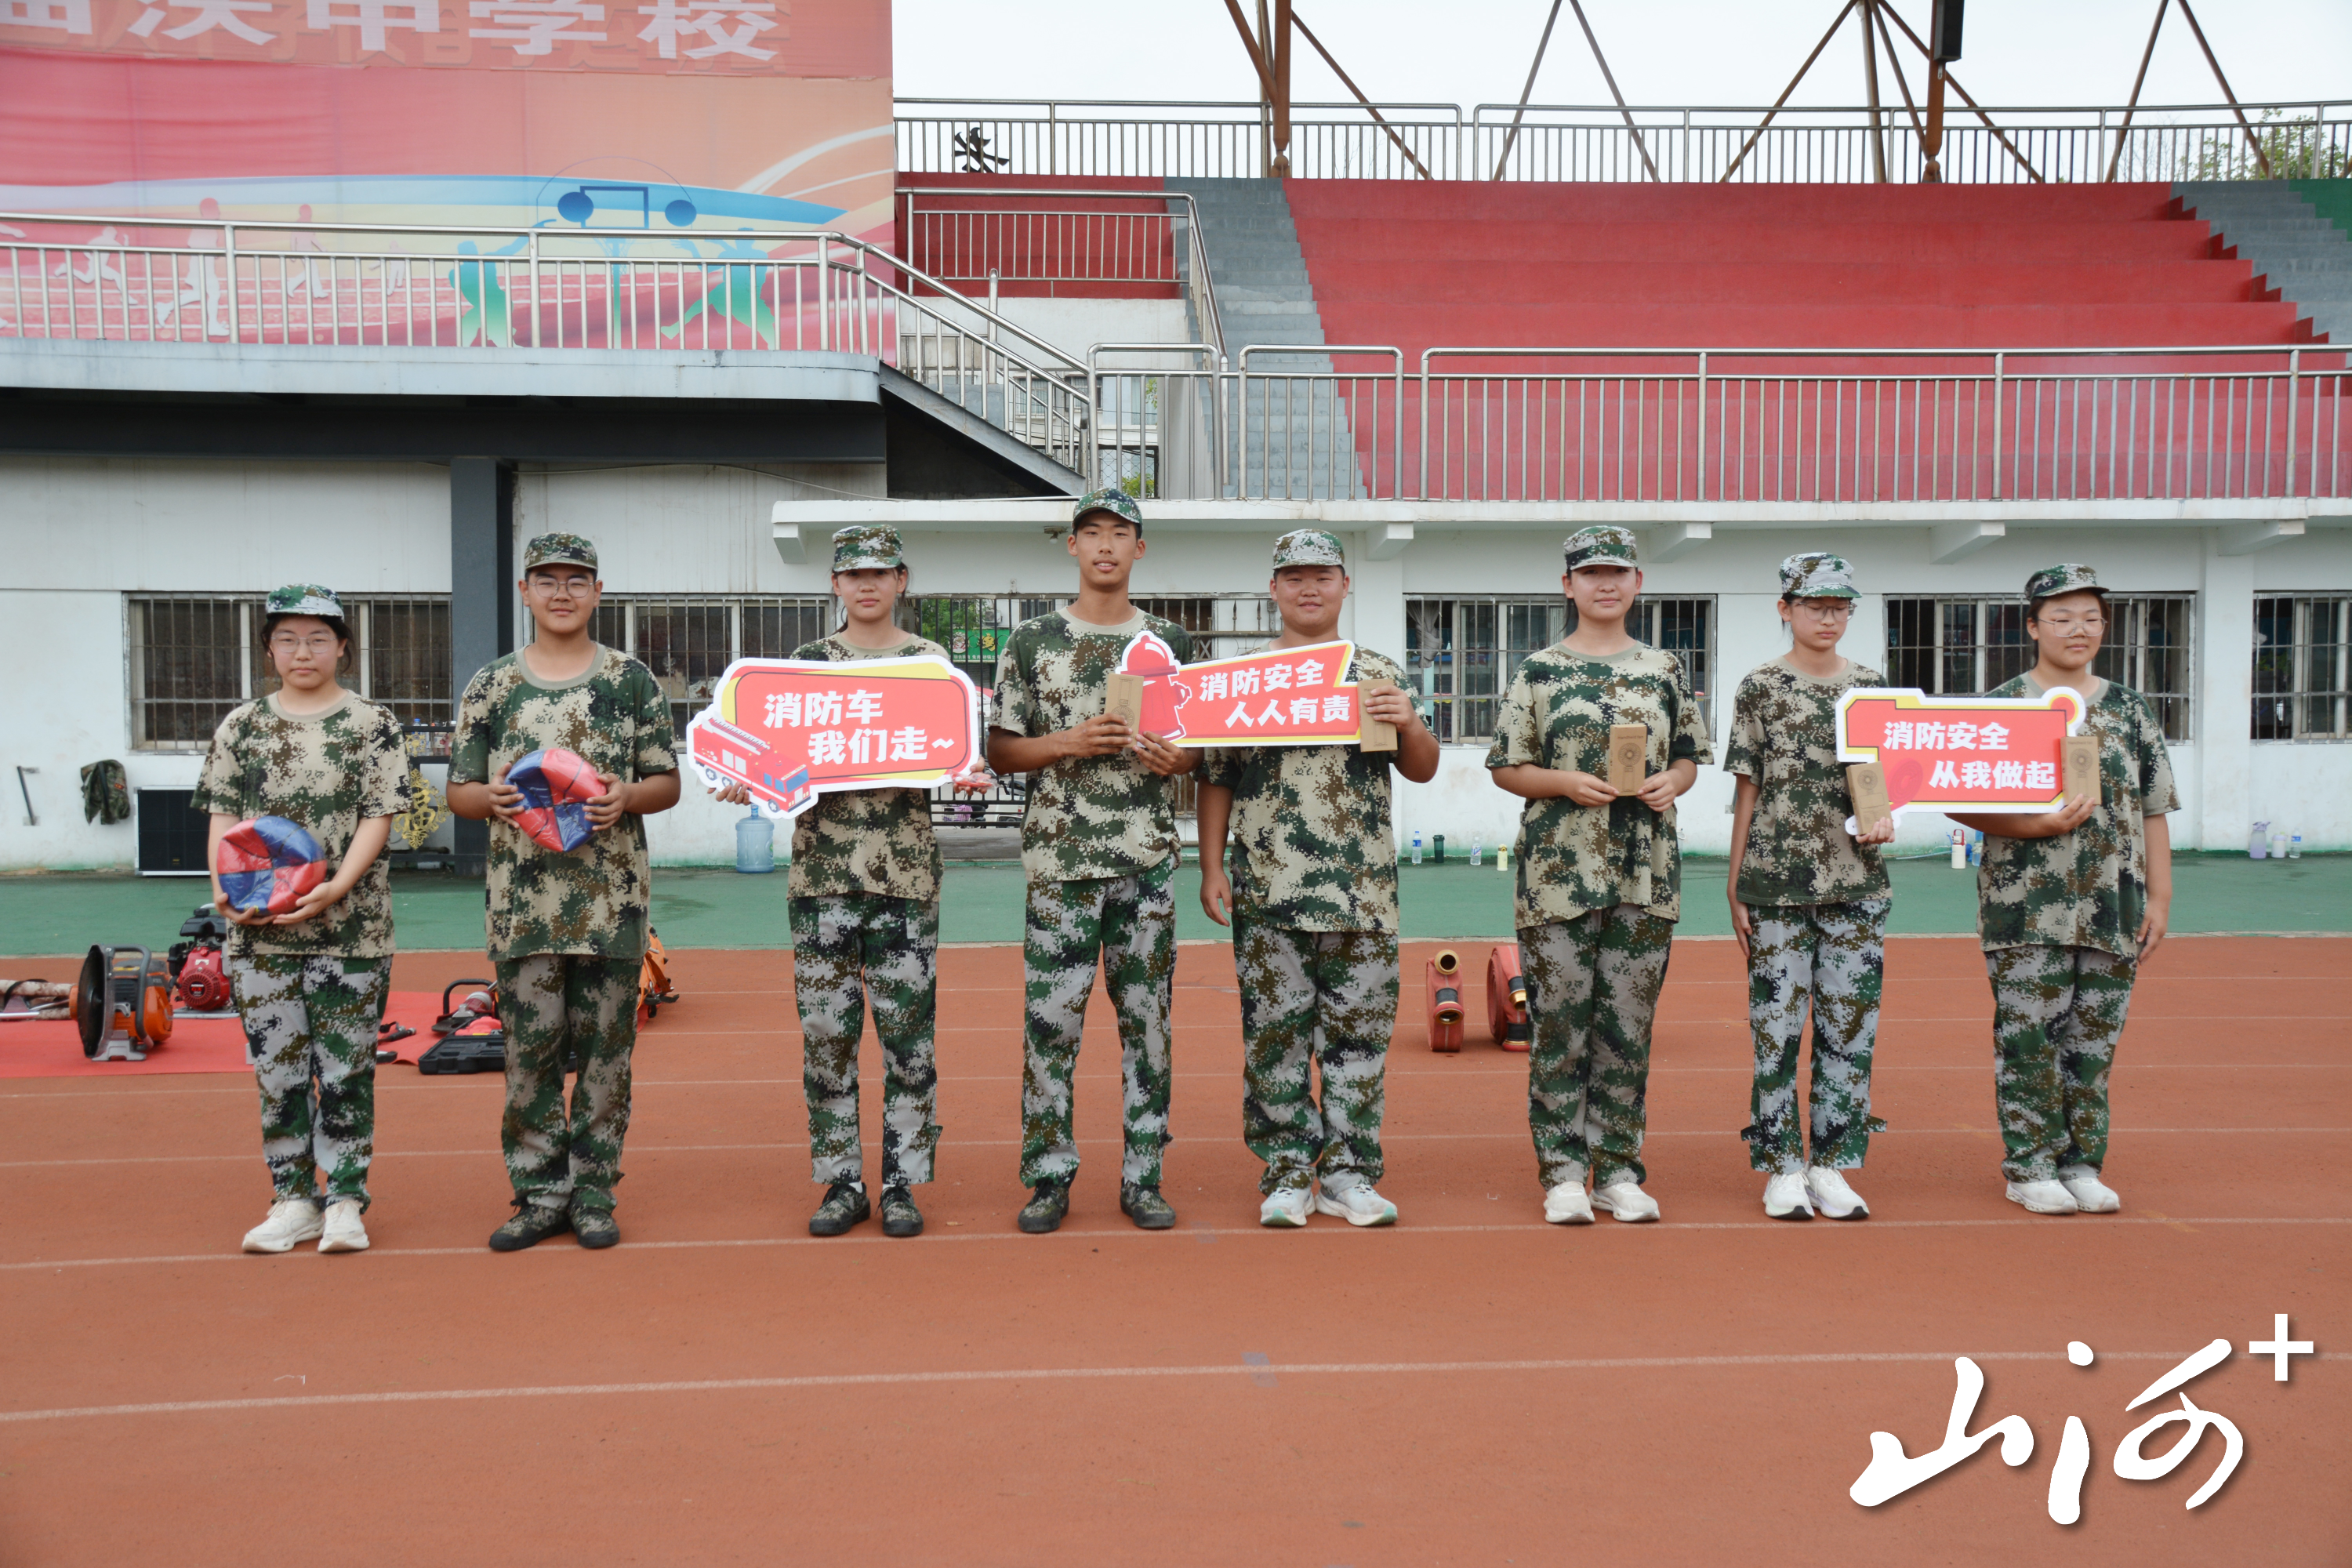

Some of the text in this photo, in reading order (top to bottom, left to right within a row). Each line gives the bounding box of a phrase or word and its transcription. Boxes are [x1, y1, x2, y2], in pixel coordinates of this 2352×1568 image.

[1200, 659, 1325, 702] 消防安全
[763, 689, 884, 728] 消防车
[1225, 695, 1351, 729] 人人有责
[1883, 721, 2010, 751] 消防安全
[1929, 760, 2056, 789] 从我做起
